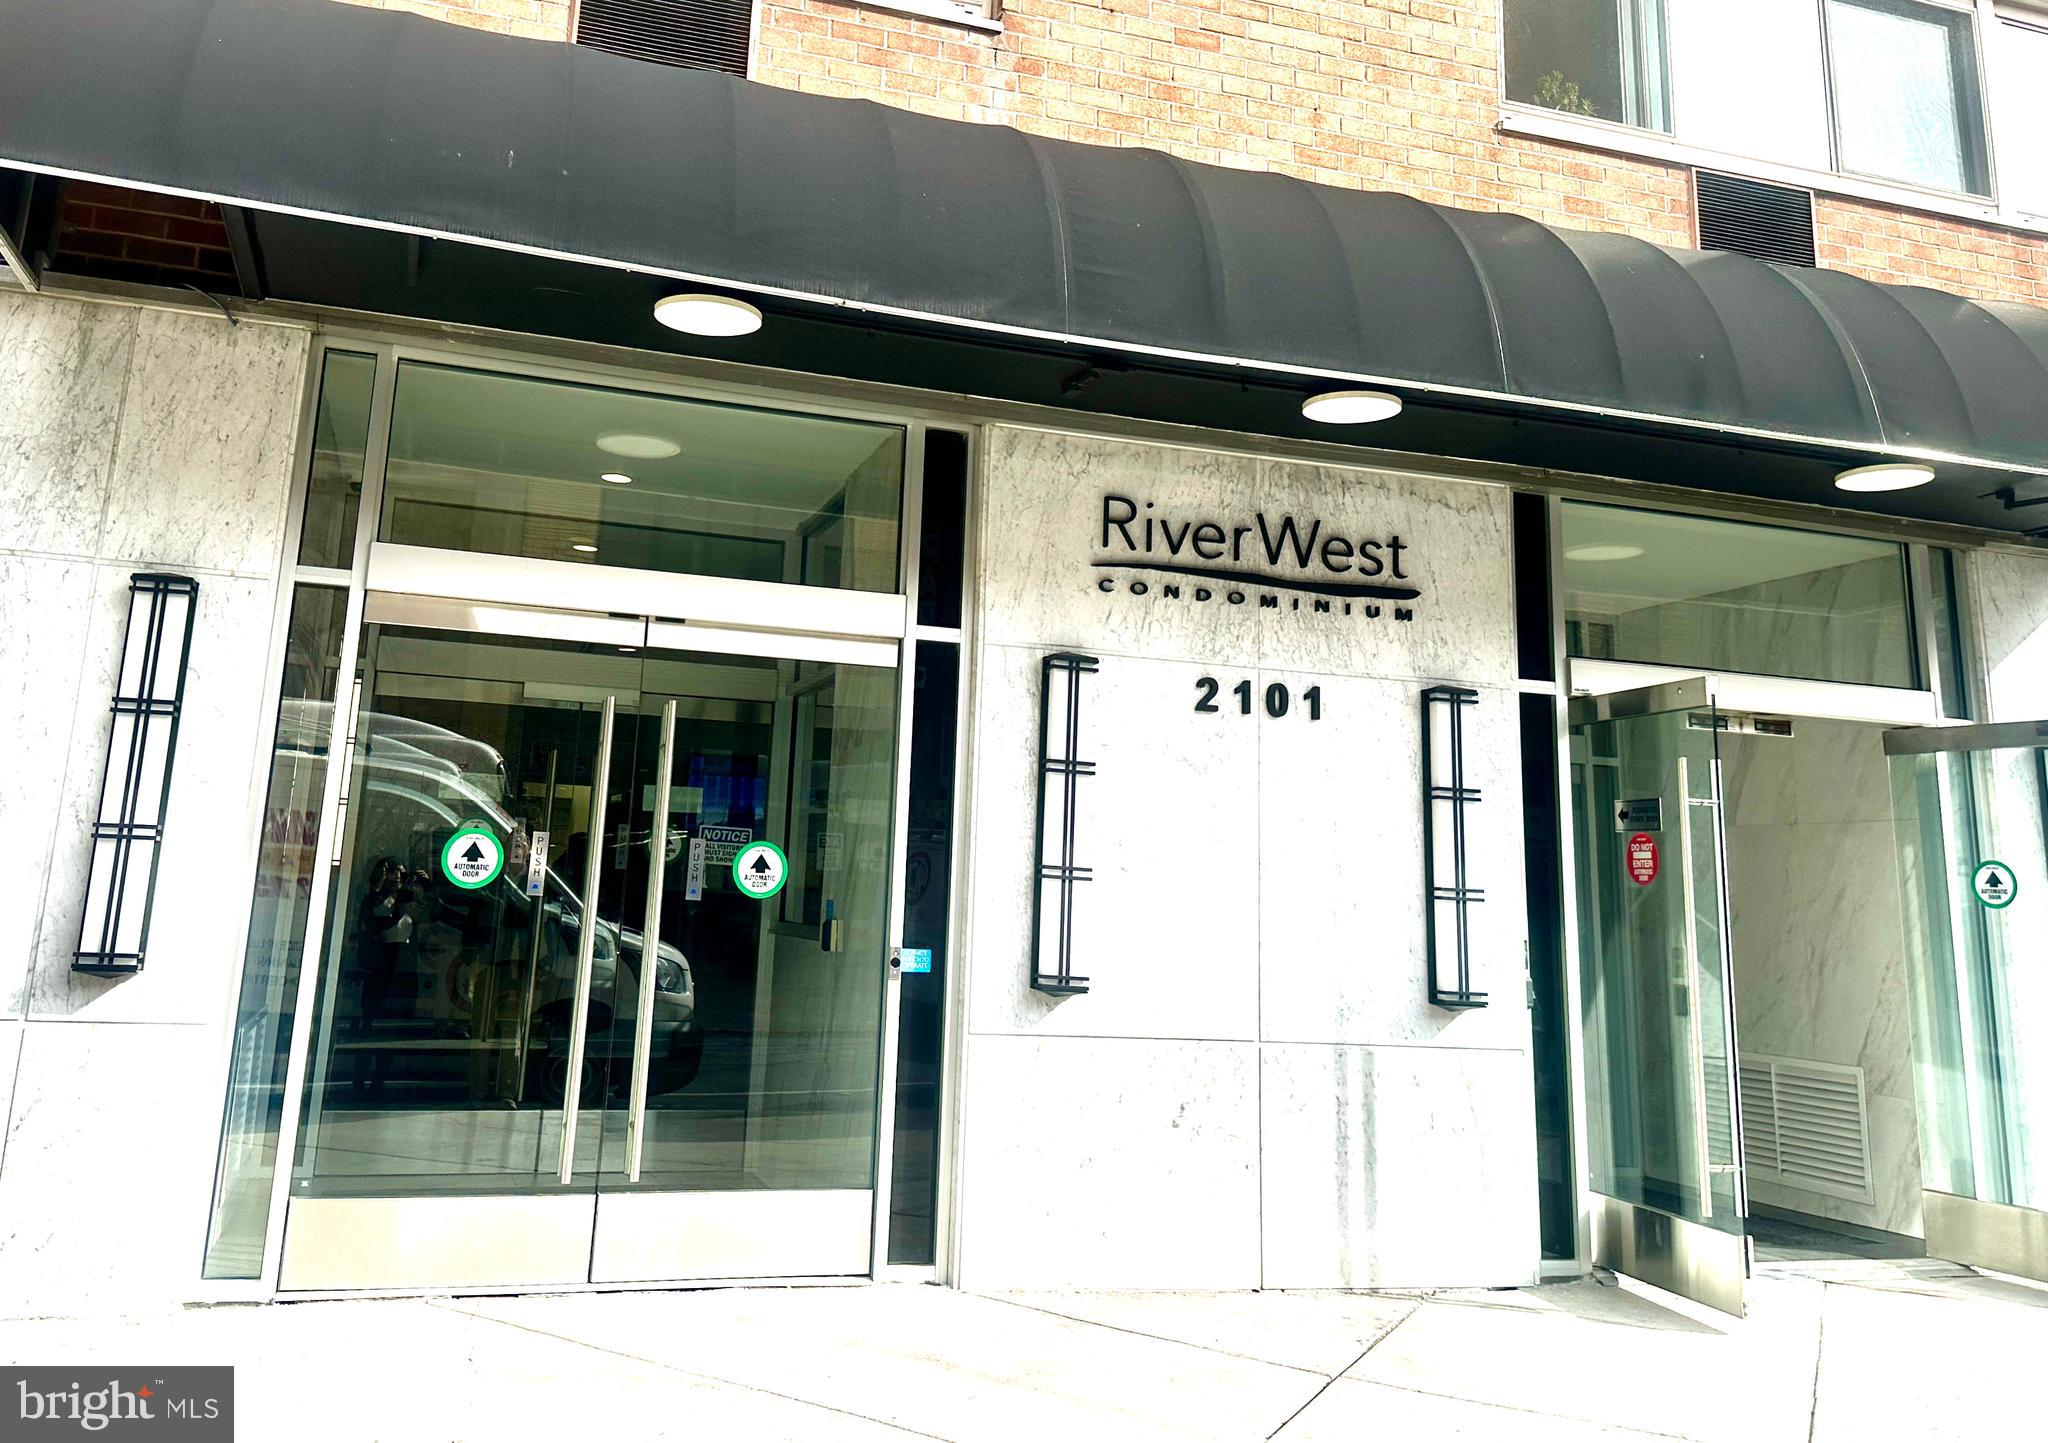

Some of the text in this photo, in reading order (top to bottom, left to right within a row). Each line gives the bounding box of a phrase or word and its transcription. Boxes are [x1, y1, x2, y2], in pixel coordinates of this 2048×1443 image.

[1101, 494, 1409, 580] RiverWest
[1098, 577, 1414, 622] CONDOMINIUM
[1194, 676, 1322, 721] 2101
[703, 829, 749, 842] NOTICE
[1641, 843, 1653, 851] NOT
[533, 836, 545, 877] PUSH
[691, 843, 701, 882] PUSH
[454, 862, 490, 872] AUTOMATIC
[1632, 860, 1653, 868] ENTER
[462, 870, 480, 878] DOOR
[744, 874, 776, 883] AUTOMATIC
